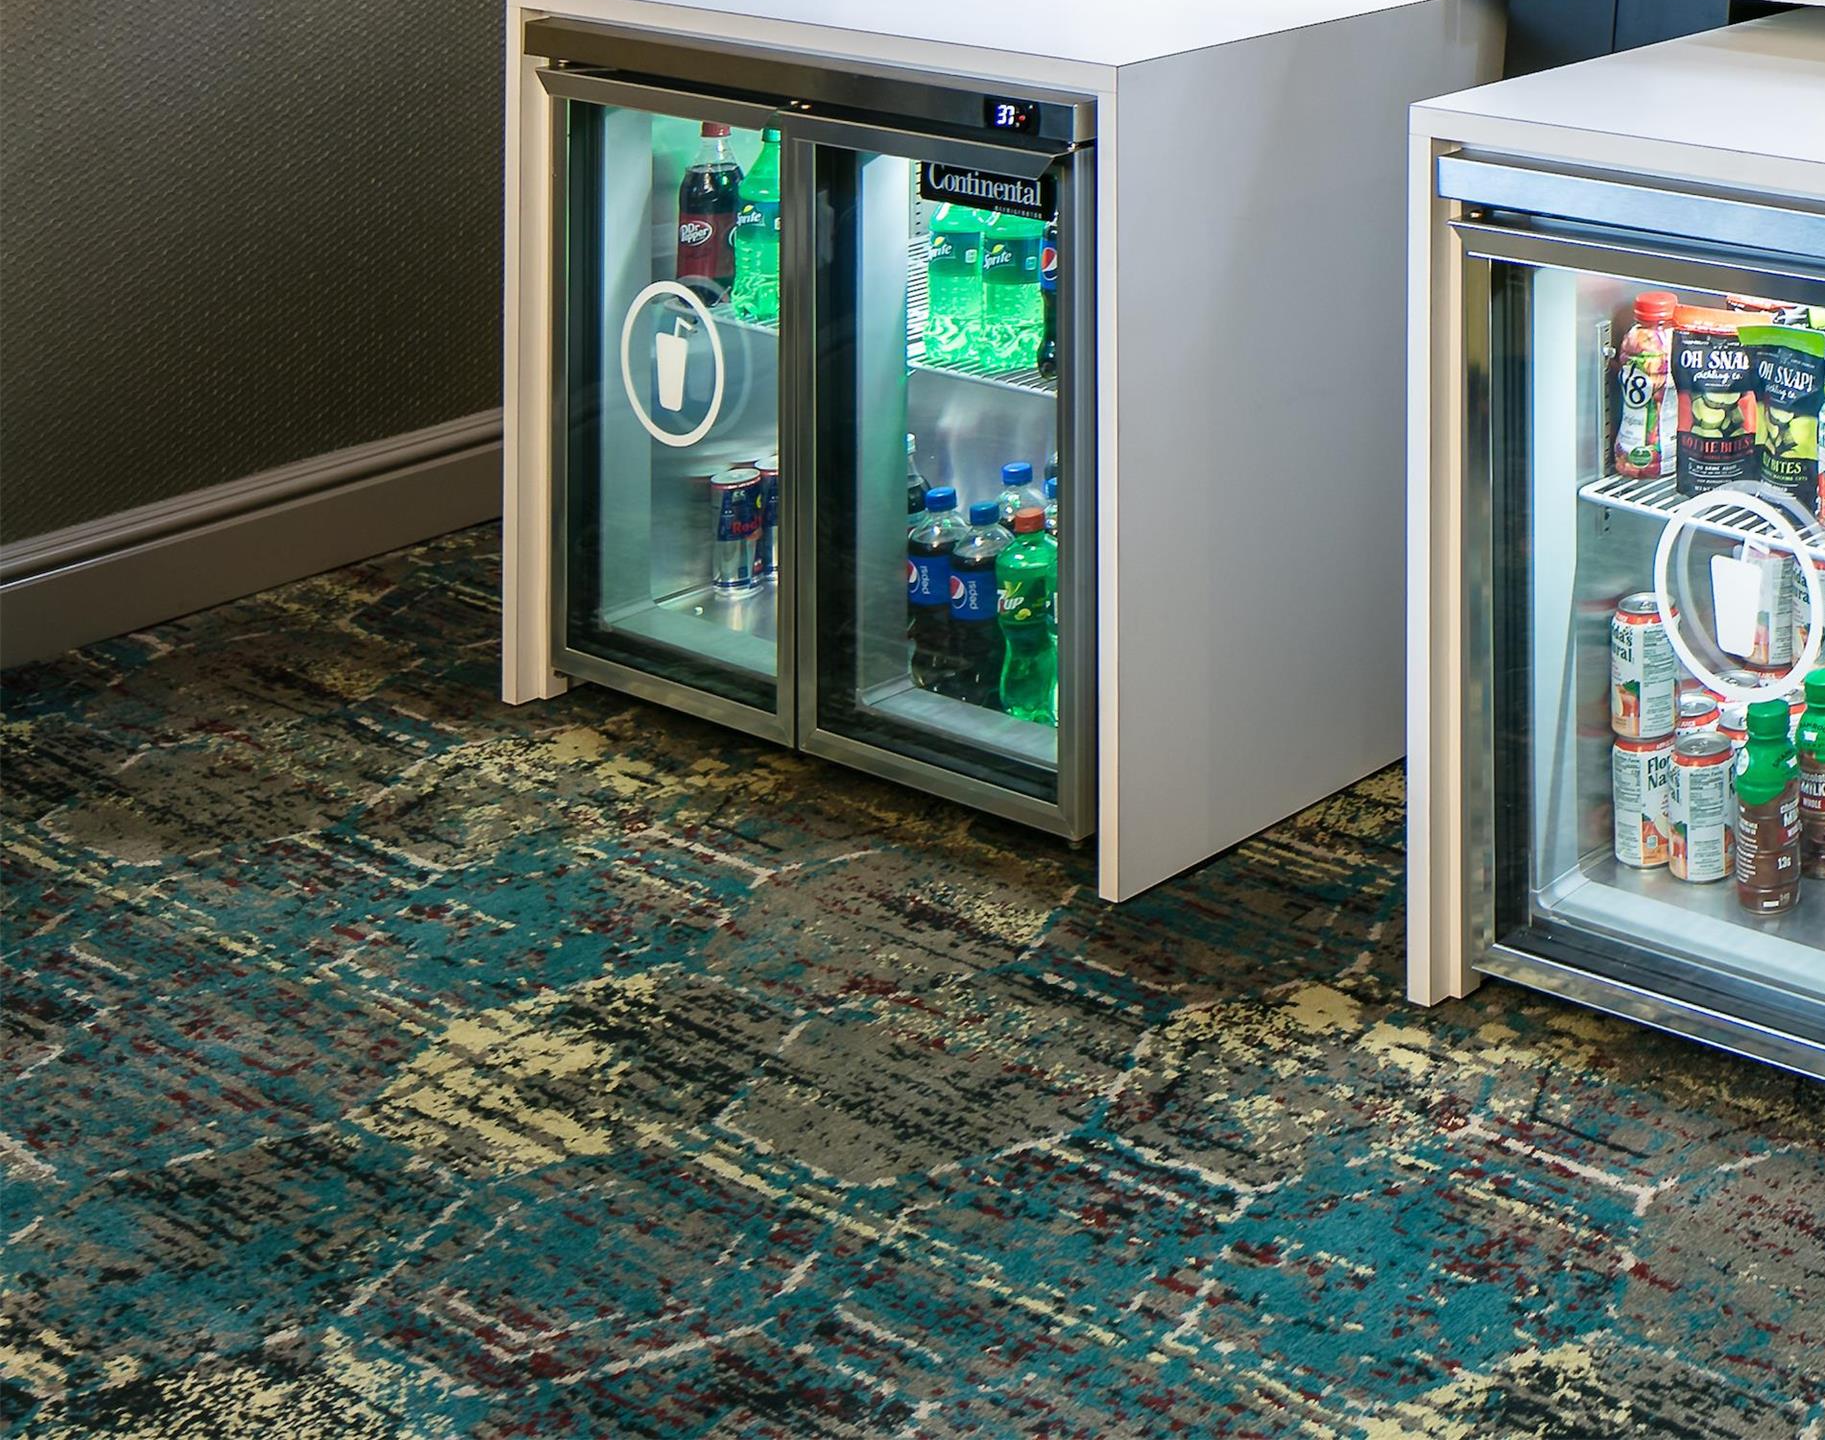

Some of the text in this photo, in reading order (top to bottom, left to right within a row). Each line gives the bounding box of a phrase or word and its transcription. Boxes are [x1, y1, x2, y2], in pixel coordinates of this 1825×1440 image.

[996, 104, 1016, 126] 37
[928, 162, 1043, 208] Continental
[736, 212, 762, 226] Sprite
[983, 249, 1013, 270] Sprite
[1680, 350, 1703, 369] OH
[1758, 360, 1774, 379] OH
[1773, 460, 1802, 474] BITES
[919, 564, 932, 596] pepsi
[967, 579, 980, 611] pepsi
